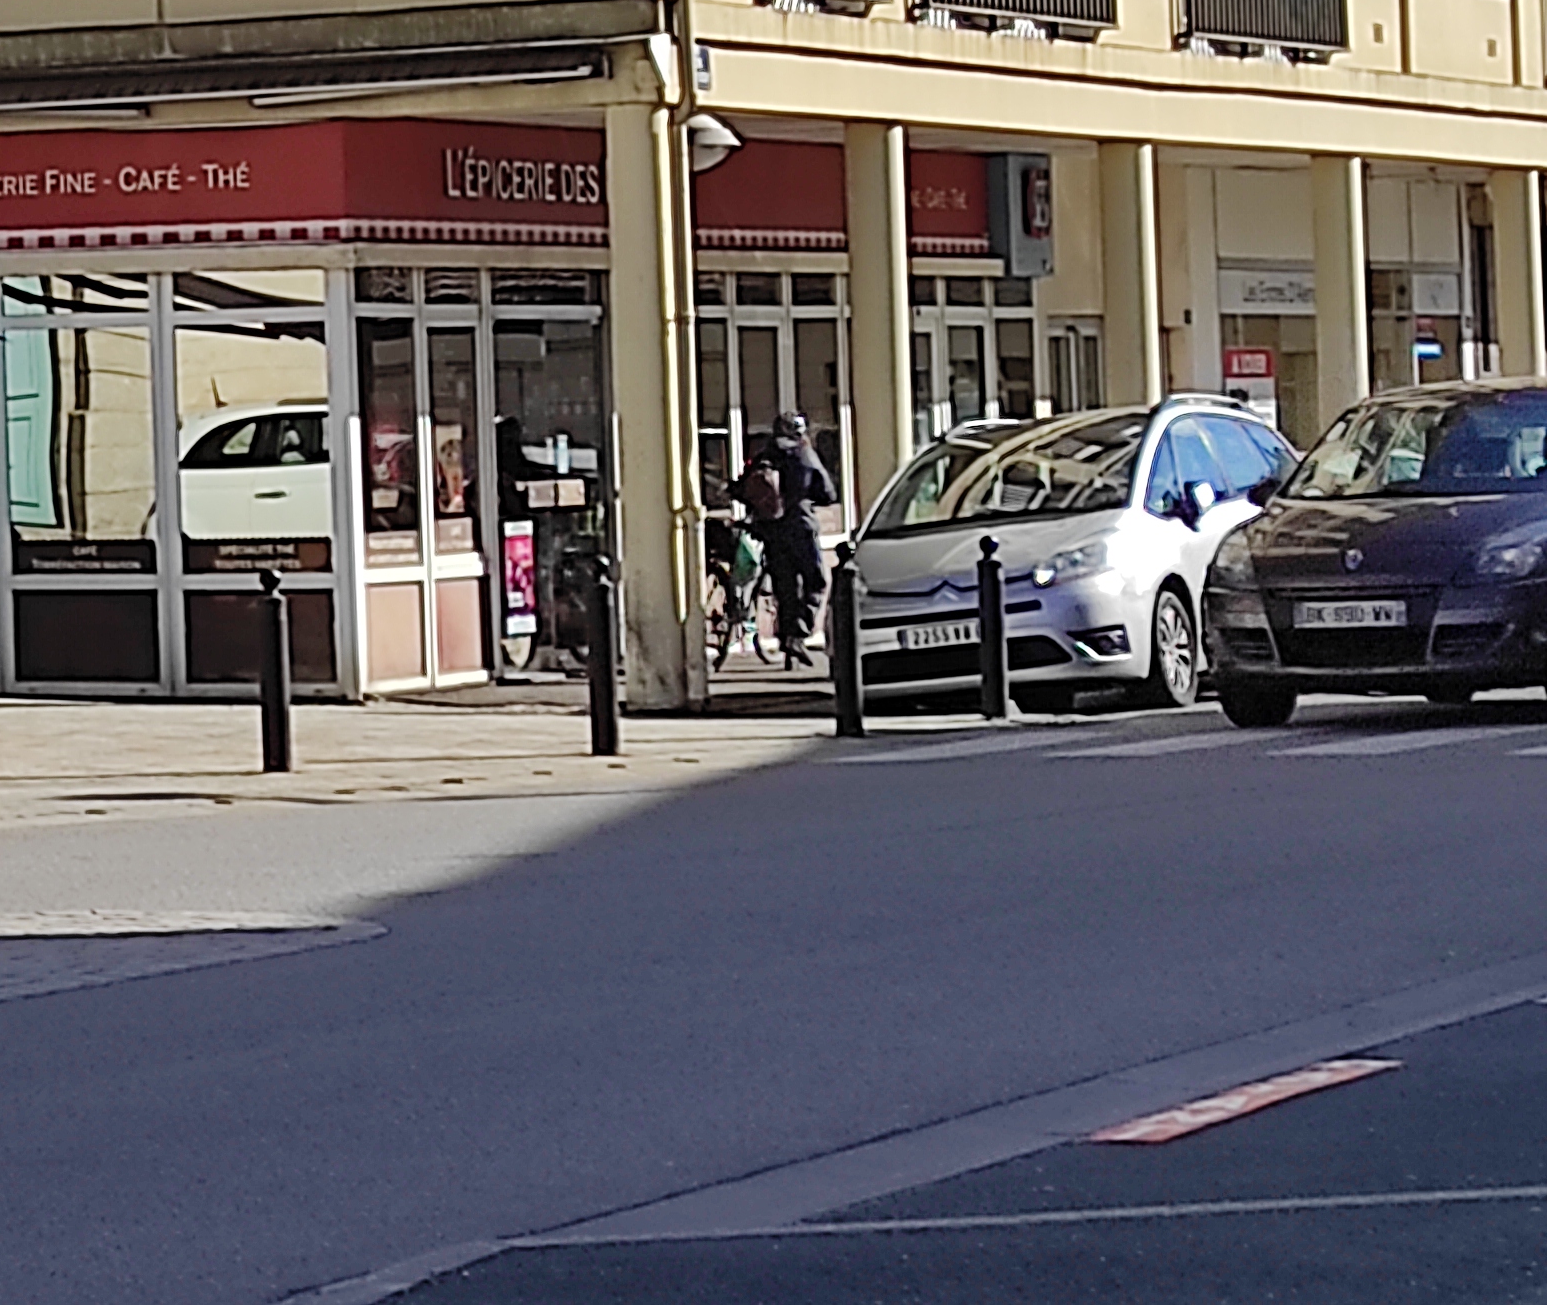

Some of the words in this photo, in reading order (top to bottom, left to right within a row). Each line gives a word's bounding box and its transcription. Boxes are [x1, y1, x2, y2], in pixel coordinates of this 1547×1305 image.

[45, 168, 96, 195] FINE
[118, 163, 182, 193] CAFÉ
[201, 161, 251, 190] THÉ
[445, 145, 557, 202] L'ÉPICERIE
[560, 163, 600, 204] DES
